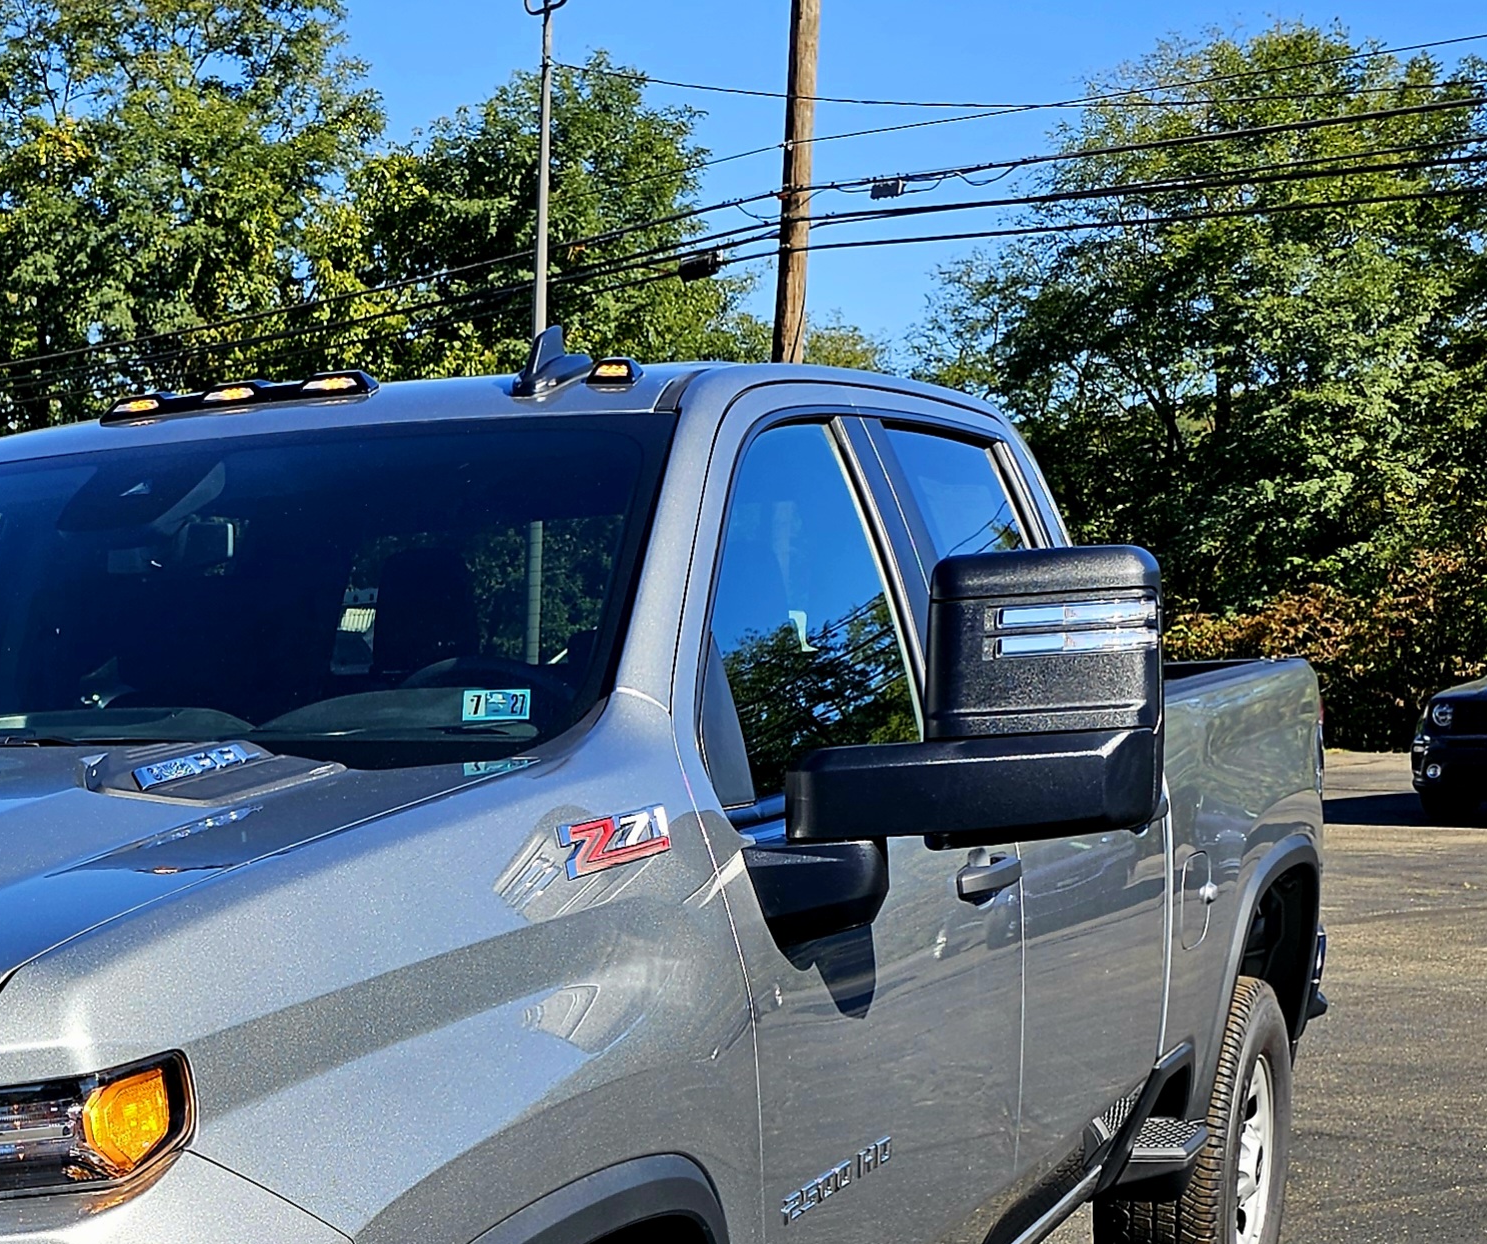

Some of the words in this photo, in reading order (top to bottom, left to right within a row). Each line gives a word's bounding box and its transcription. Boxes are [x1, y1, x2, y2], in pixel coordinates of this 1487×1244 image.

[471, 694, 483, 716] 7
[510, 693, 526, 716] 27
[555, 803, 672, 881] Z71
[779, 1158, 852, 1226] 2500
[857, 1135, 892, 1179] HD
